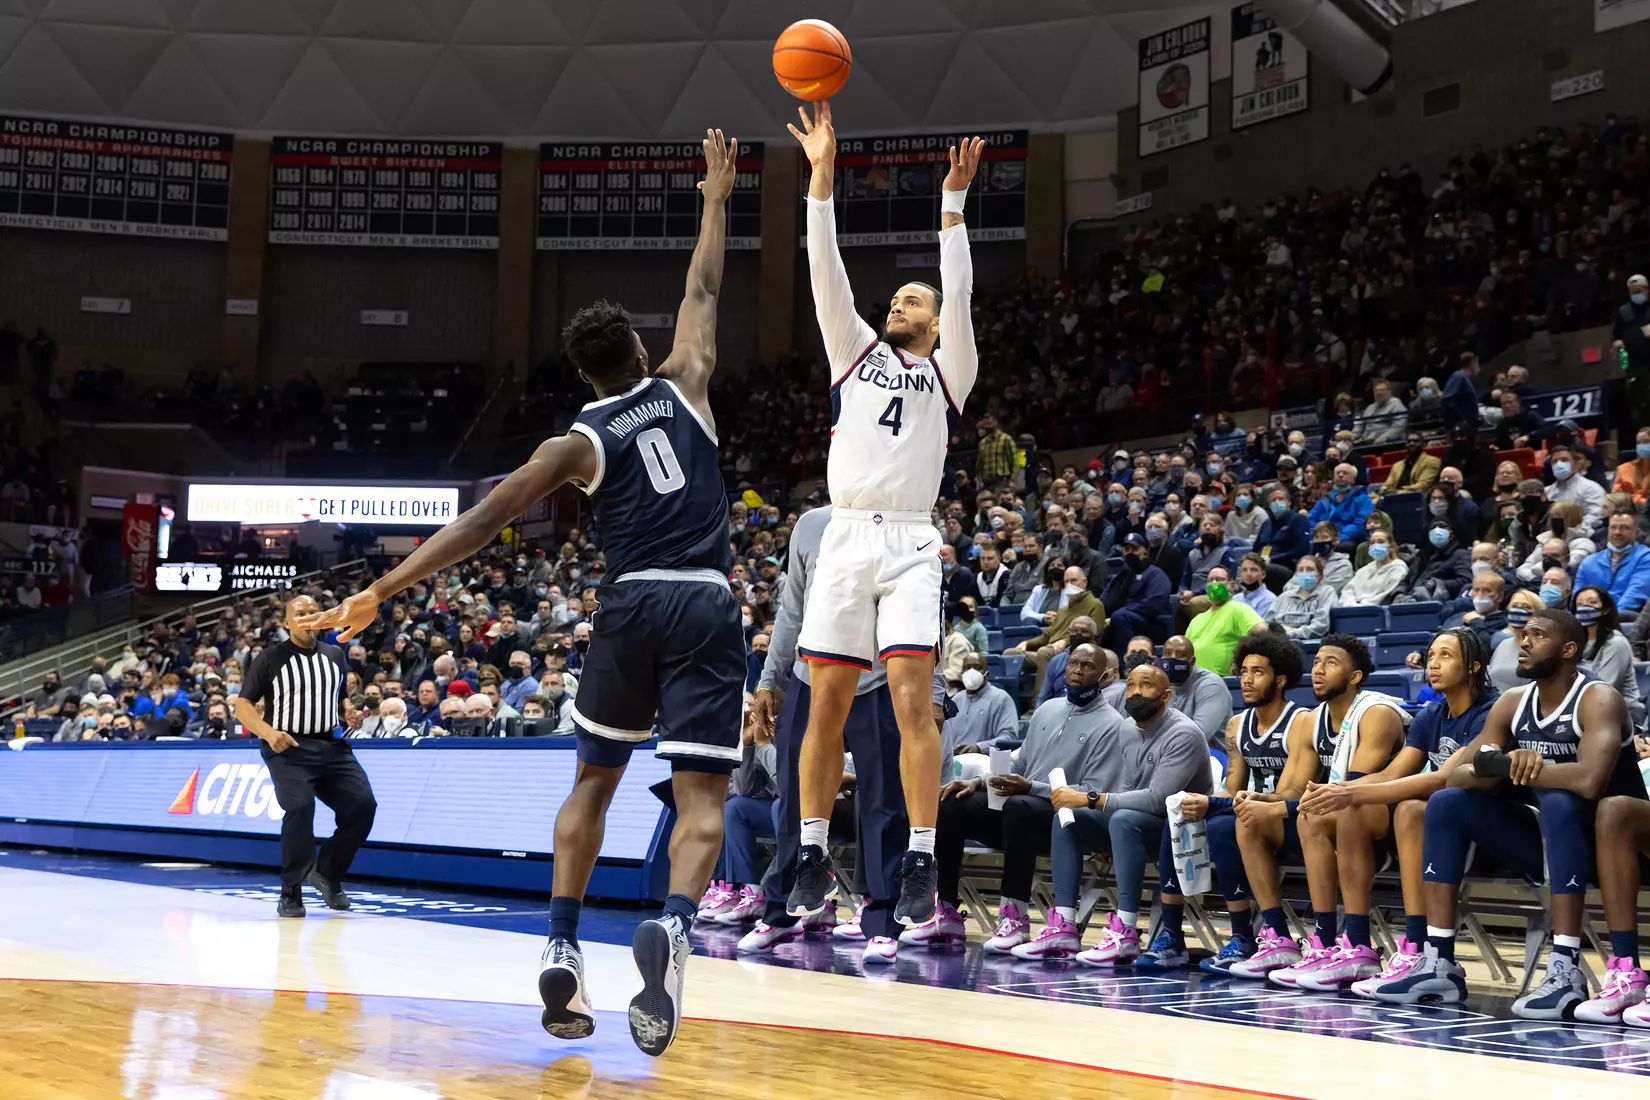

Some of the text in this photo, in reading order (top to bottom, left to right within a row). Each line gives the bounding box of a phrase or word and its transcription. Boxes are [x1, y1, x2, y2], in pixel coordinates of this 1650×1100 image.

[1573, 74, 1602, 92] 220
[4, 119, 220, 147] NCAA CHAMPIONSHIP
[2, 134, 221, 160] TOURNAMENT APPEARANCES
[286, 140, 490, 156] NCAA CHAMPIONSHIP
[873, 133, 1014, 152] CHAMPIOHIP
[552, 145, 751, 158] NCAA CHAMPIONP
[872, 153, 912, 164] FINAL
[330, 155, 446, 168] SWEET SIXTEEN
[608, 160, 695, 170] ELITE EIGHT
[26, 173, 52, 191] 2011
[638, 196, 662, 211] 2014
[0, 214, 83, 229] ONNECTICUT
[136, 225, 219, 238] BASKETBALL
[307, 214, 332, 229] 2011
[339, 215, 364, 230] 2014
[276, 232, 362, 244] CONNECTICUT
[412, 236, 493, 247] BASKETBALL
[542, 239, 627, 248] CONNECTICUT
[838, 235, 890, 245] ECTICUT
[969, 230, 1019, 240] ETBALL
[394, 313, 402, 323] 8
[858, 364, 934, 394] UCONN
[1552, 392, 1594, 417] 121
[606, 400, 674, 440] MOHAMMED
[878, 396, 904, 436] 4
[636, 427, 685, 494] 0
[245, 498, 294, 515] SOBER
[319, 499, 347, 515] GET
[351, 500, 408, 516] PULLED
[412, 500, 451, 517] OVER
[32, 561, 56, 576] 117
[1175, 848, 1203, 859] POWERADE
